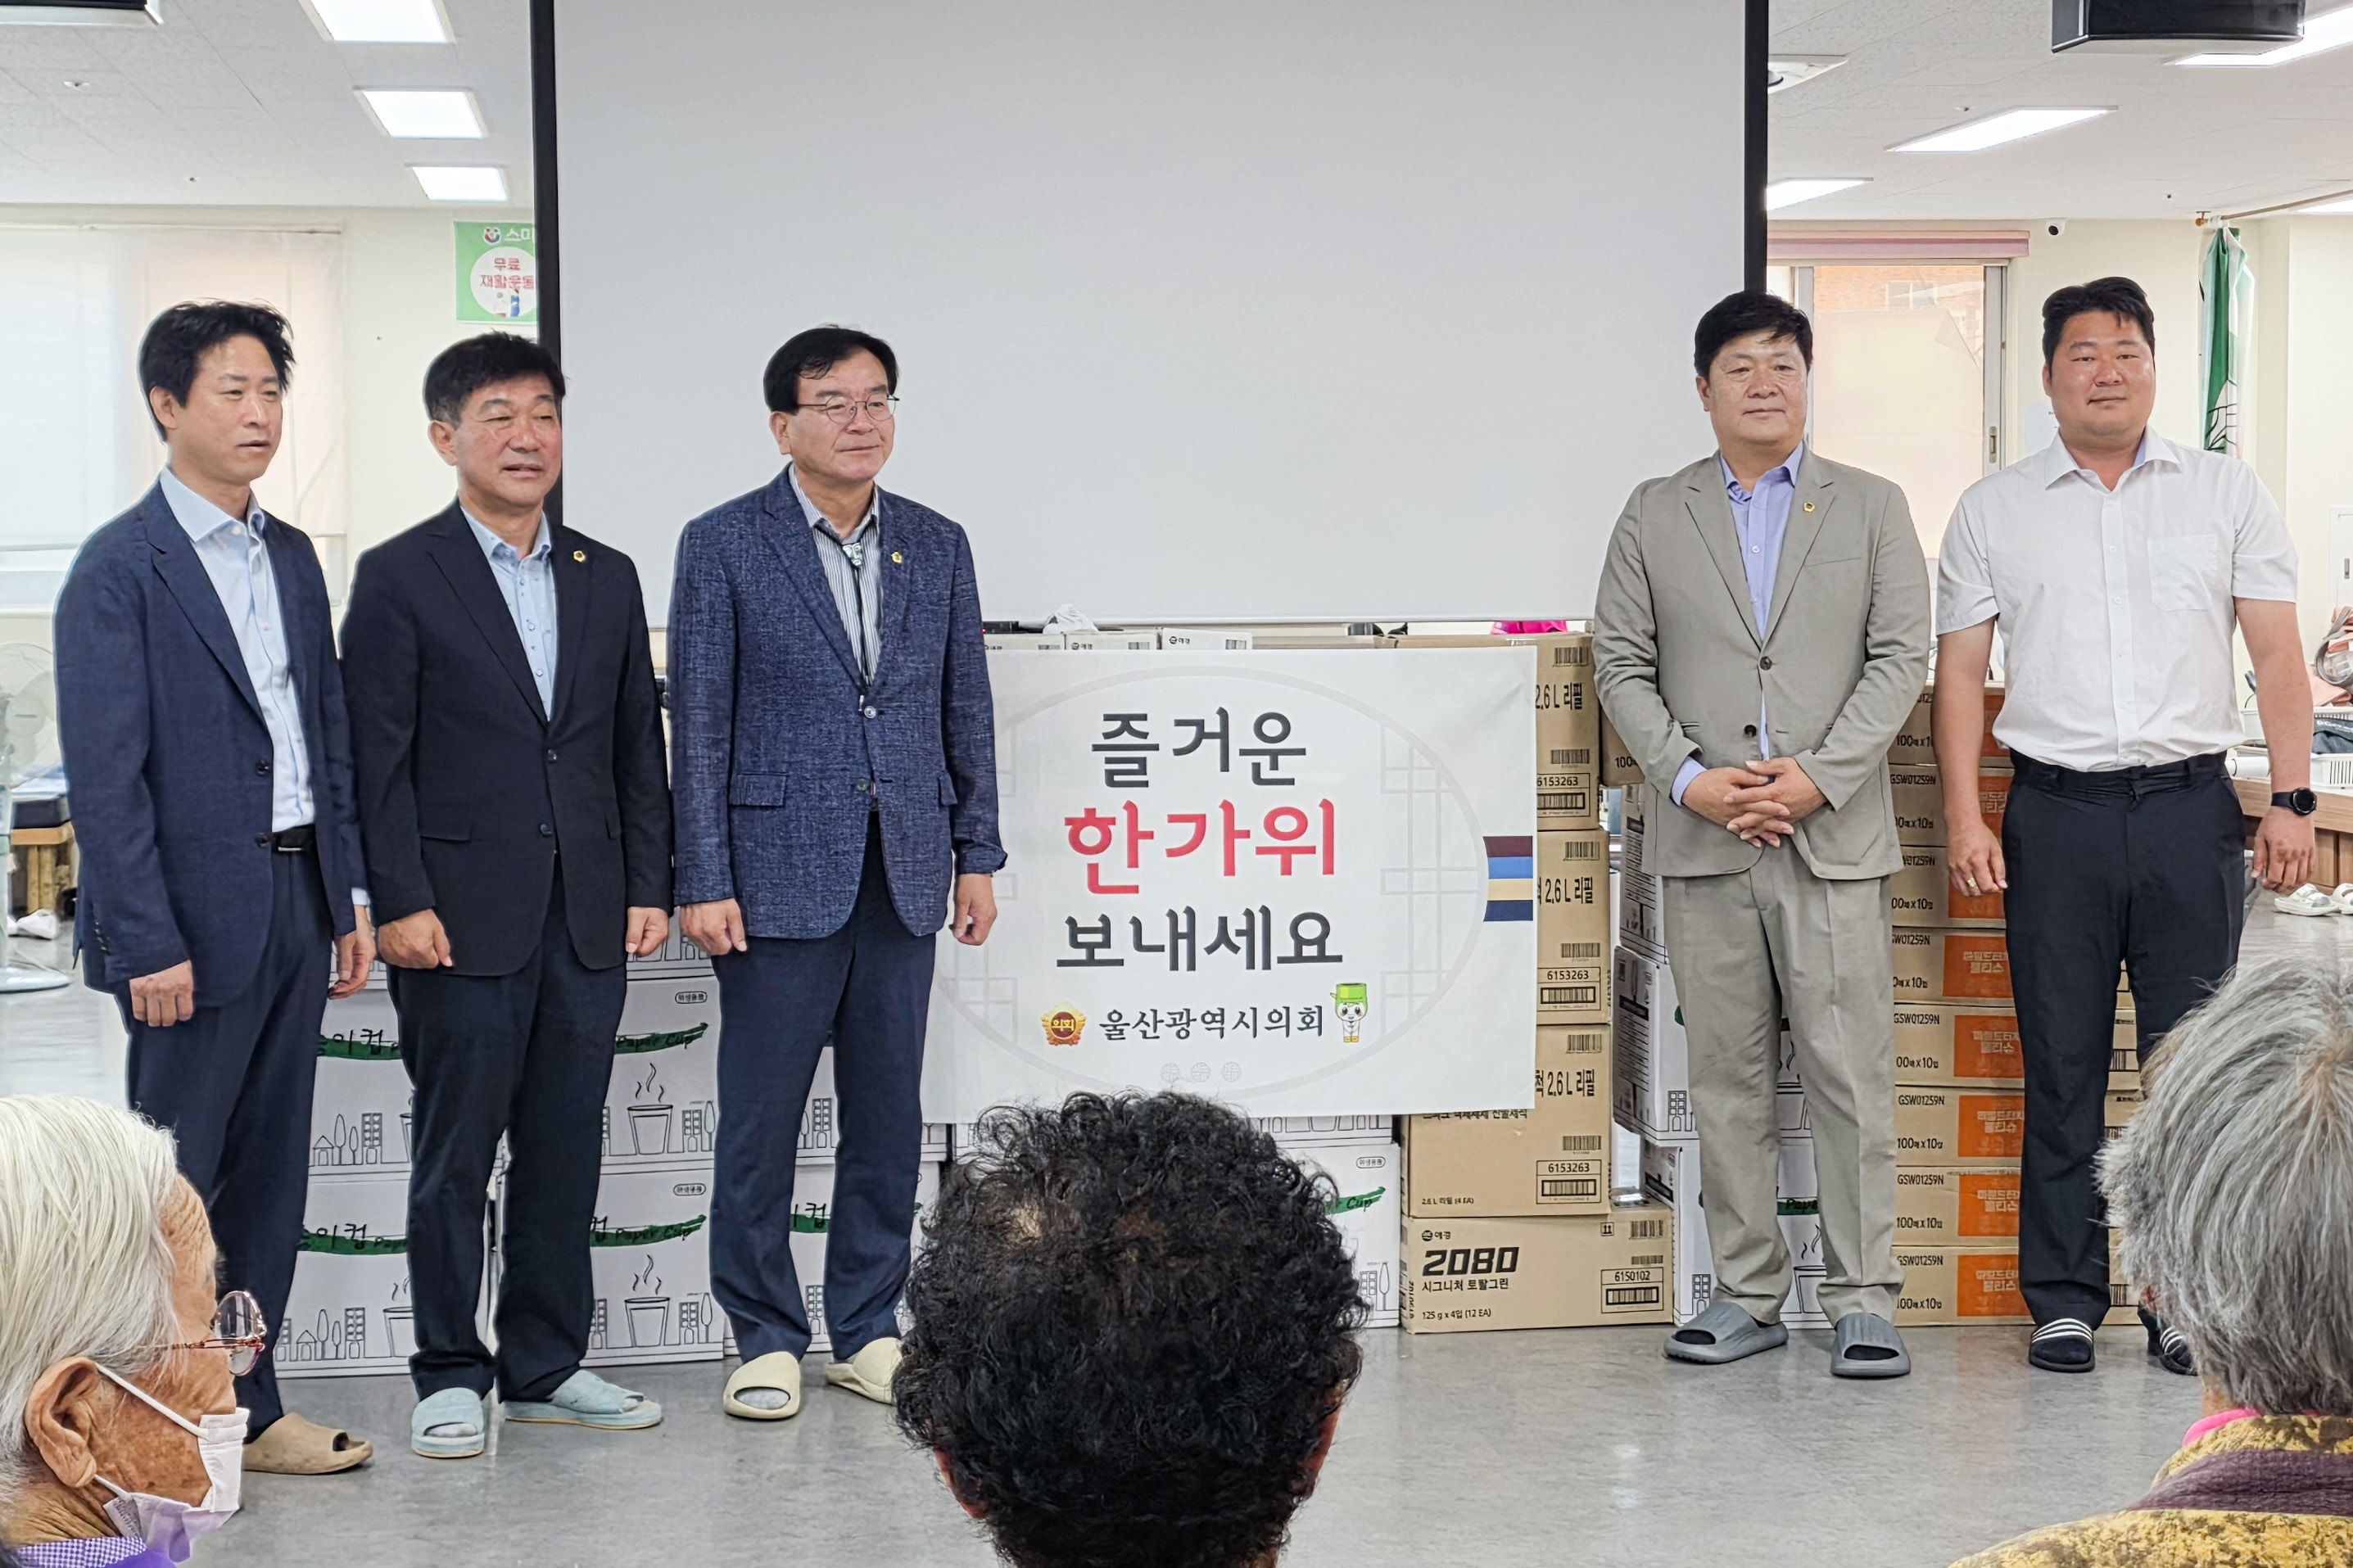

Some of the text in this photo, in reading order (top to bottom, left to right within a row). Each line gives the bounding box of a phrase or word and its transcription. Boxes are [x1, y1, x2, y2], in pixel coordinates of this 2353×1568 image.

[495, 258, 520, 271] 무료
[1554, 684, 1560, 708] L
[1563, 682, 1582, 710] 리필
[1092, 706, 1306, 788] 즐거운
[1536, 776, 1579, 787] 6153263
[1064, 798, 1335, 894] 한가위
[1545, 878, 1561, 904] 2.6
[1564, 878, 1571, 902] L
[1574, 876, 1593, 904] 리필
[1057, 905, 1343, 972] 보내세요
[1547, 969, 1590, 980] 6153263
[1052, 1019, 1074, 1032] 의회
[1099, 1005, 1324, 1042] 울산광역시의회
[1894, 1013, 1940, 1025] GSW01259N
[319, 1029, 383, 1055] 이컵
[1547, 1071, 1563, 1096] 2.6
[1567, 1071, 1572, 1096] L
[1576, 1069, 1595, 1097] 리필
[1898, 1095, 1945, 1105] GSW01259N
[1548, 1163, 1591, 1173] 6153263
[1897, 1174, 1944, 1186] GSW01259N
[1422, 1247, 1519, 1277] 2080
[1614, 1271, 1650, 1281] 6150102
[1422, 1280, 1464, 1293] 시그니처
[1422, 1311, 1435, 1320] 125
[1437, 1313, 1442, 1321] g
[1464, 1309, 1476, 1318] (12
[1478, 1308, 1491, 1317] EA)
